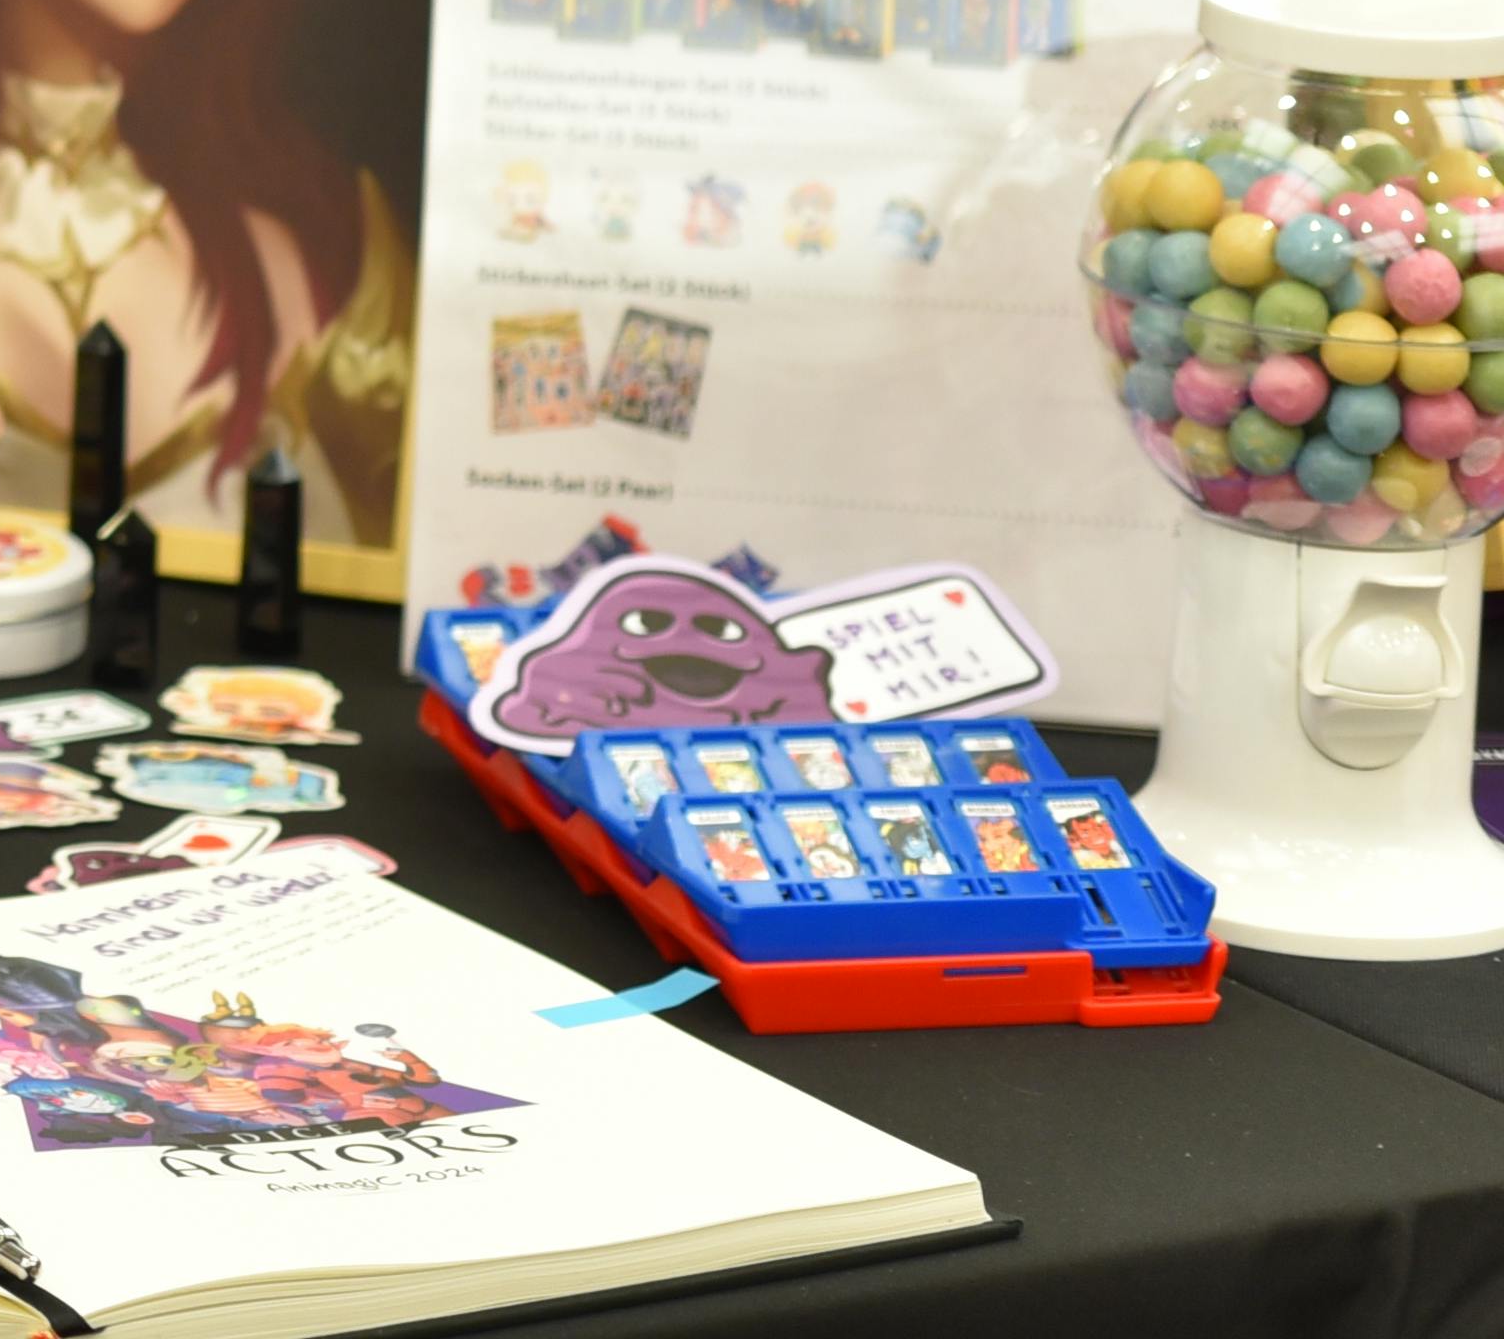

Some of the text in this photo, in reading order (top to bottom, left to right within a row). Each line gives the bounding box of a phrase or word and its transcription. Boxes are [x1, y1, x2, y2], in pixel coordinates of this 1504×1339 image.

[825, 611, 934, 650] SPIEL
[866, 635, 940, 672] MIT
[159, 1123, 520, 1179] ACTORS
[230, 1123, 354, 1144] DICE
[266, 1165, 485, 1196] AnimagiC 2024
